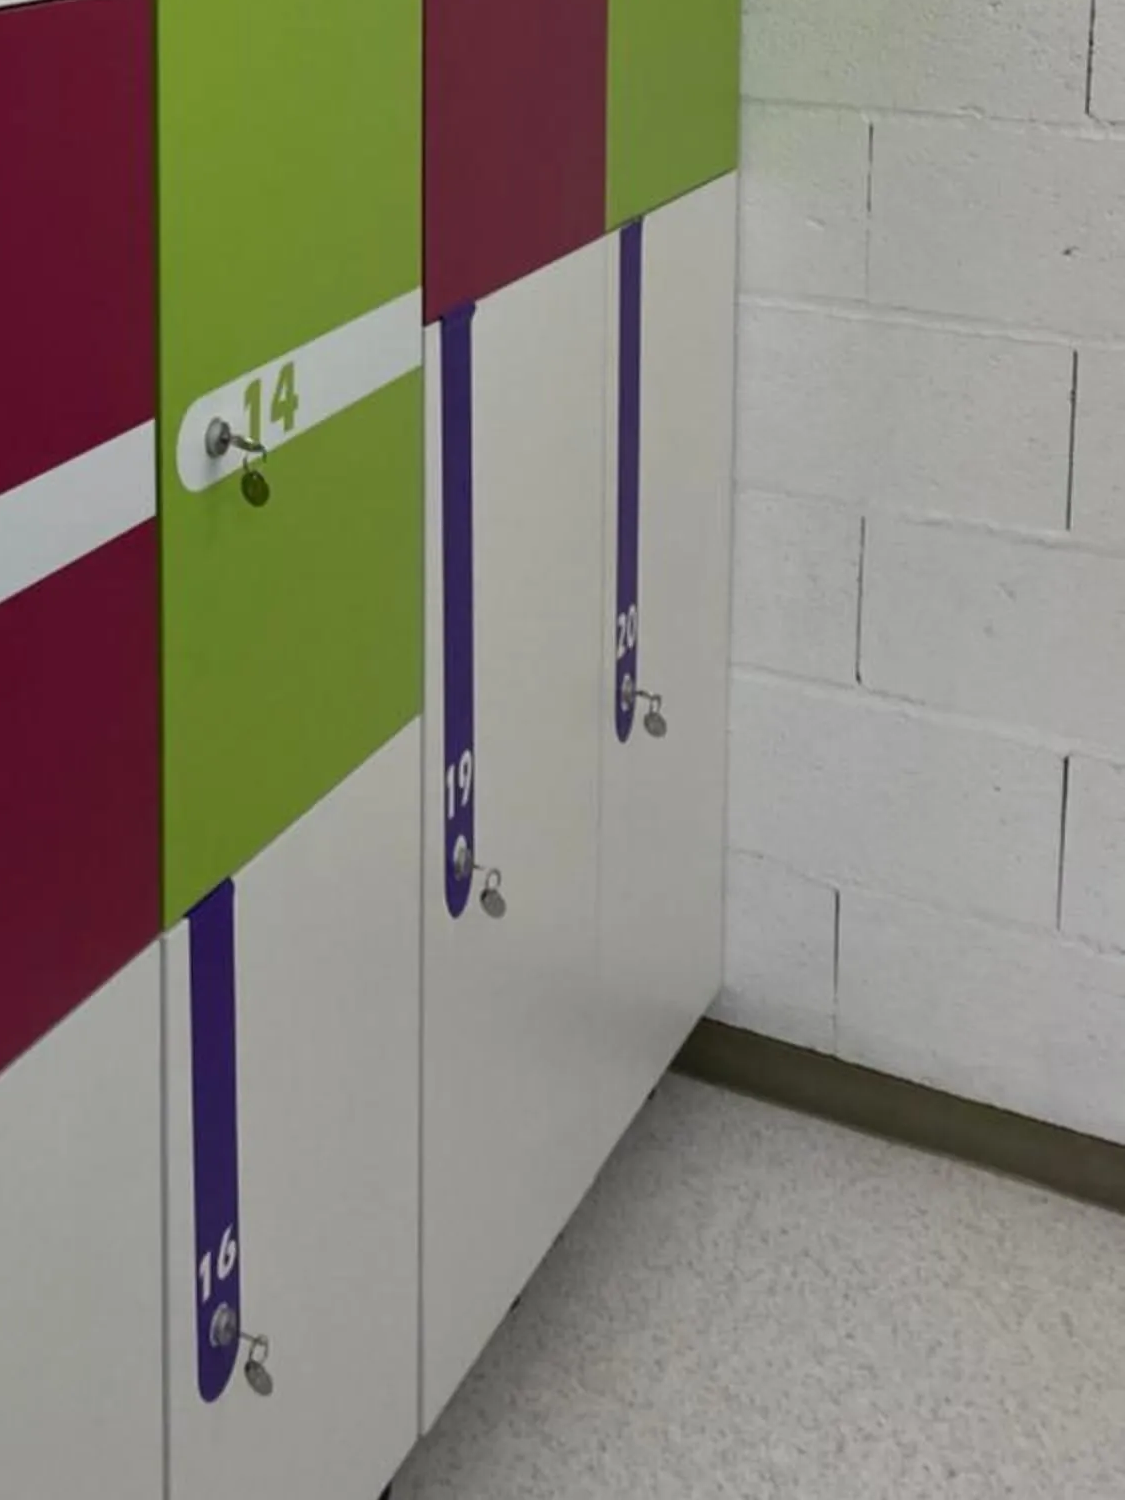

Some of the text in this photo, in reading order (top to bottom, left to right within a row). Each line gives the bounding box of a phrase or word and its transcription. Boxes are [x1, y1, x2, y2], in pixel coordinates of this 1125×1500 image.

[244, 361, 299, 443] 14
[616, 603, 636, 661] 20
[447, 749, 472, 820] 19
[199, 1222, 236, 1304] 16
